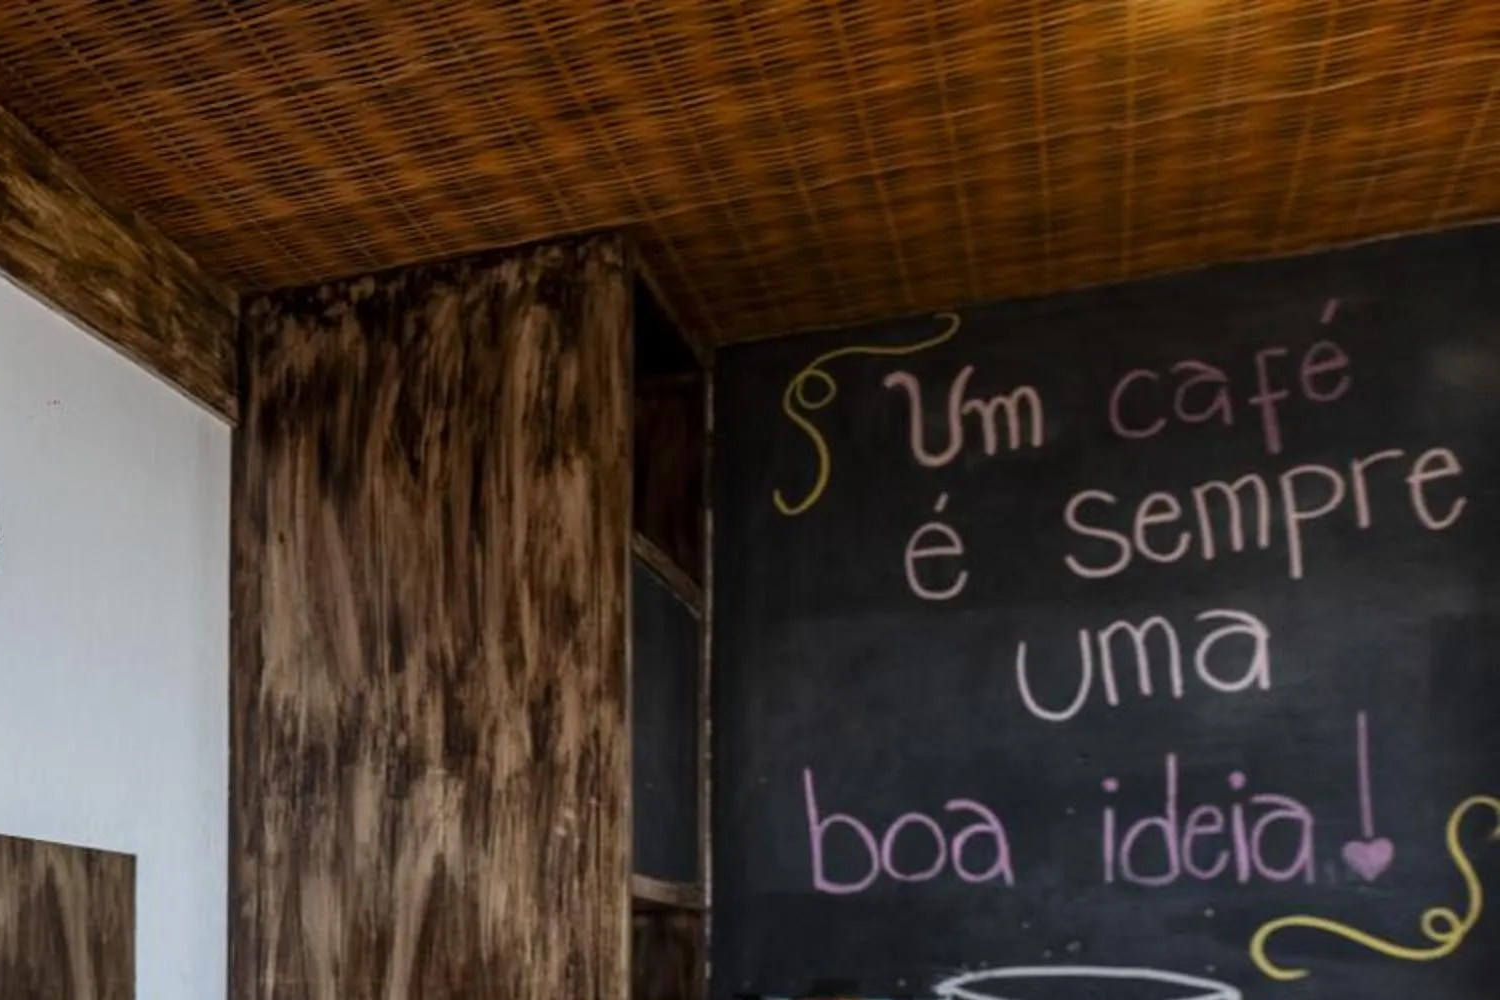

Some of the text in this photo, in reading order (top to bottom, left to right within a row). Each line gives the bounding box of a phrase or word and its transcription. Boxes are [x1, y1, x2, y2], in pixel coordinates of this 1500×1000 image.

[884, 299, 1352, 467] Um café
[904, 492, 969, 600] é
[1016, 609, 1270, 721] uma
[803, 767, 1014, 894] boa
